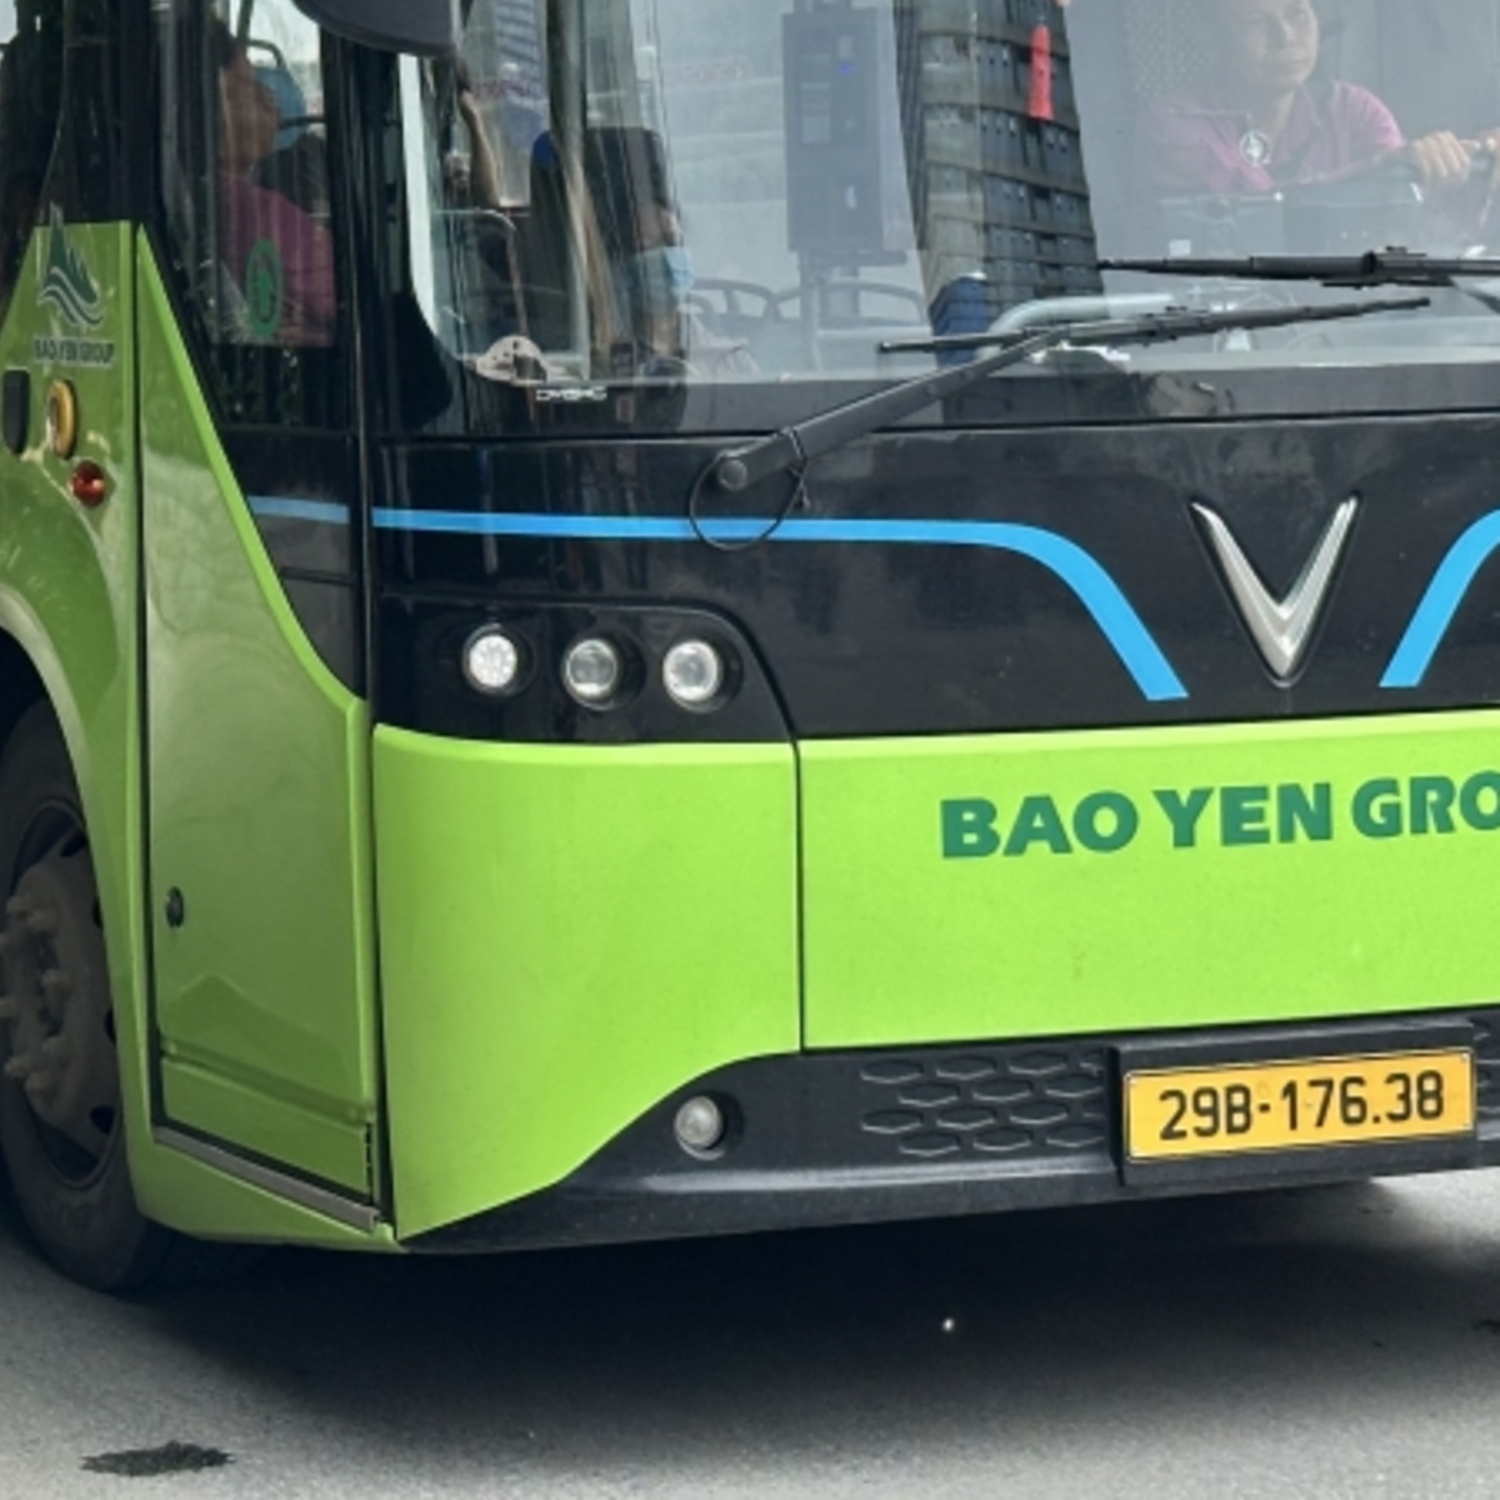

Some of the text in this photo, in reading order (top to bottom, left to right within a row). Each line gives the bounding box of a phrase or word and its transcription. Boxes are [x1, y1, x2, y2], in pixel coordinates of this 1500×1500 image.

[939, 789, 1140, 859] BAO
[1151, 782, 1334, 848] YEN
[1157, 1069, 1445, 1141] 29B-176.38
